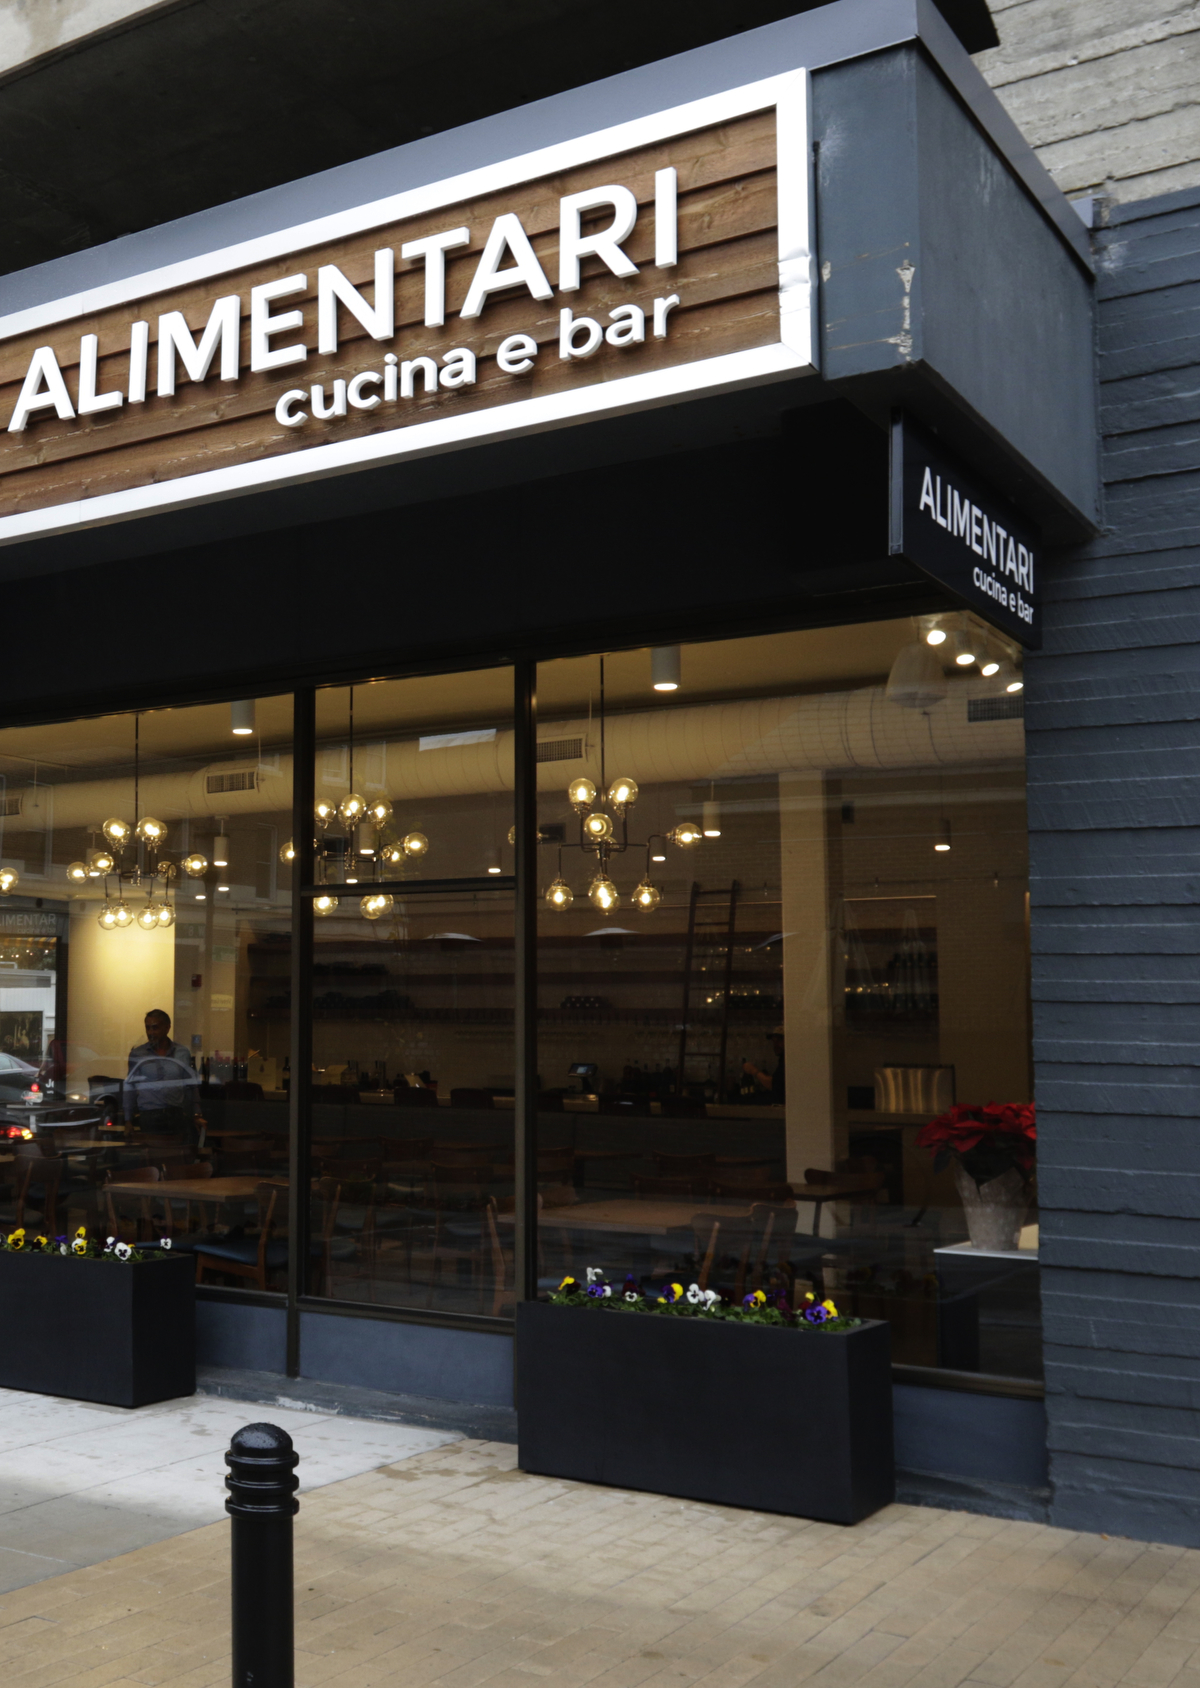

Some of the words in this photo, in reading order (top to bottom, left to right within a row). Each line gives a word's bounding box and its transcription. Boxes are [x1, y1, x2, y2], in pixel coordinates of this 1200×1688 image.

[7, 167, 678, 433] ALIMENTARI
[275, 346, 477, 428] cucina
[496, 333, 536, 375] e
[559, 293, 680, 361] bar
[919, 466, 1034, 595] ALIMENTARI
[973, 566, 1008, 608] cucina
[1009, 594, 1017, 611] e
[1017, 591, 1034, 625] bar
